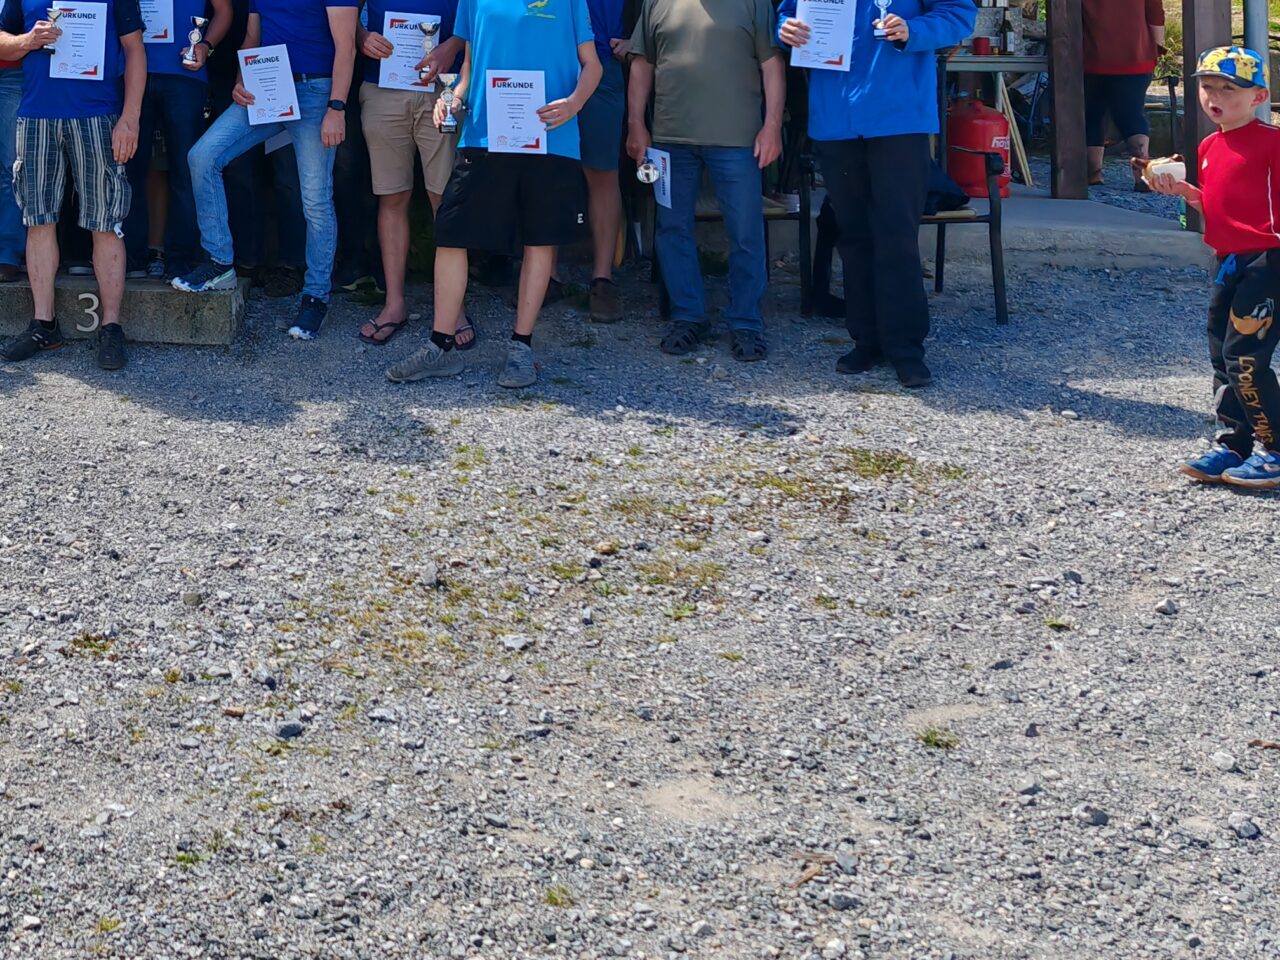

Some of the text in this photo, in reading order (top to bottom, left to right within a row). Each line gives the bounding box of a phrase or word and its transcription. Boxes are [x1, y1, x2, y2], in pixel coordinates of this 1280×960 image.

[62, 12, 97, 20] URKUNDE
[394, 23, 419, 31] URKUN
[248, 55, 280, 66] URKUNDE
[496, 81, 534, 89] URKUNDE
[76, 292, 100, 333] 3
[1238, 356, 1262, 408] LOONEY
